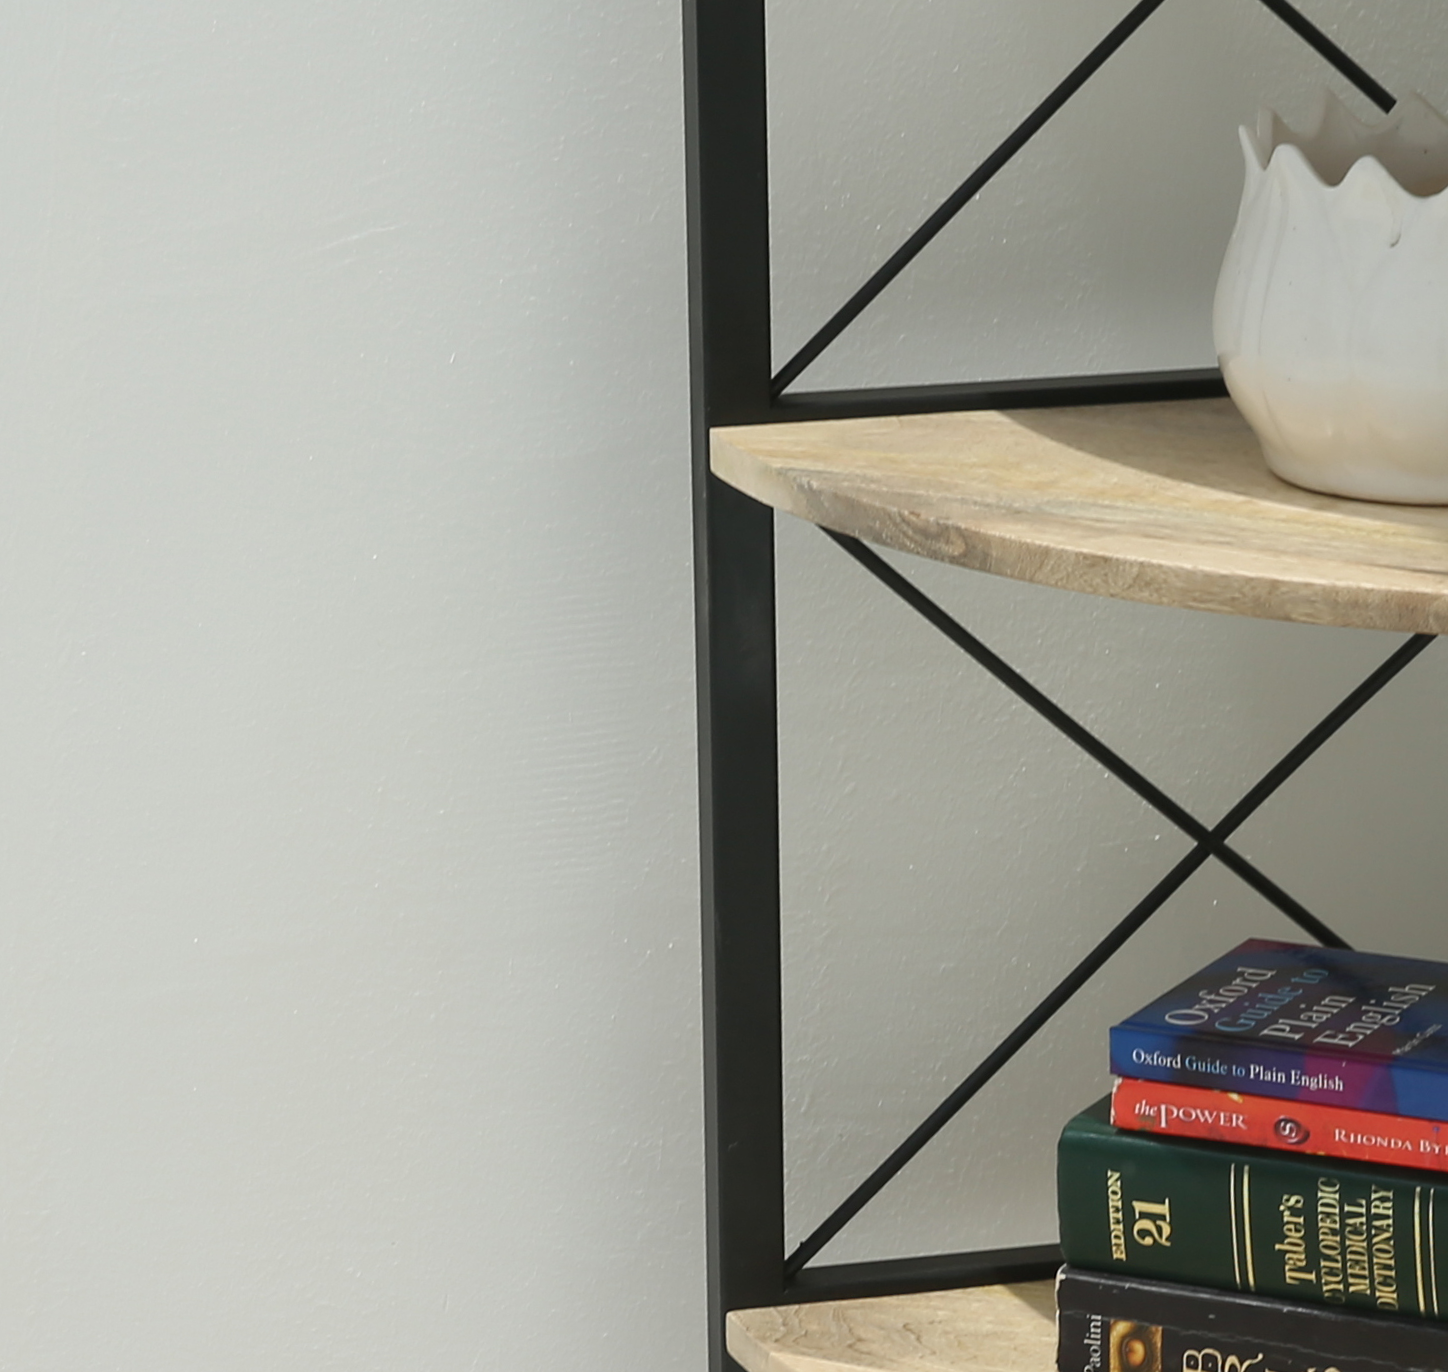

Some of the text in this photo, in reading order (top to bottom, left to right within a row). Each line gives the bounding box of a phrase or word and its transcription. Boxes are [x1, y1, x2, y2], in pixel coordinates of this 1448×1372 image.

[1165, 967, 1277, 1026] Oxford
[1215, 968, 1329, 1032] Guide to
[1259, 995, 1356, 1040] Plain
[1313, 983, 1436, 1048] English
[1132, 1048, 1344, 1092] Oxford Guide to Plain English
[1134, 1099, 1248, 1130] the POWER
[1334, 1128, 1413, 1152] RHONDA
[1107, 1169, 1127, 1262] EDITION
[1131, 1197, 1172, 1247] 21
[1275, 1194, 1316, 1285] Taber's
[1344, 1198, 1370, 1295] MEDICAL
[1371, 1183, 1399, 1311] DICTIONARY
